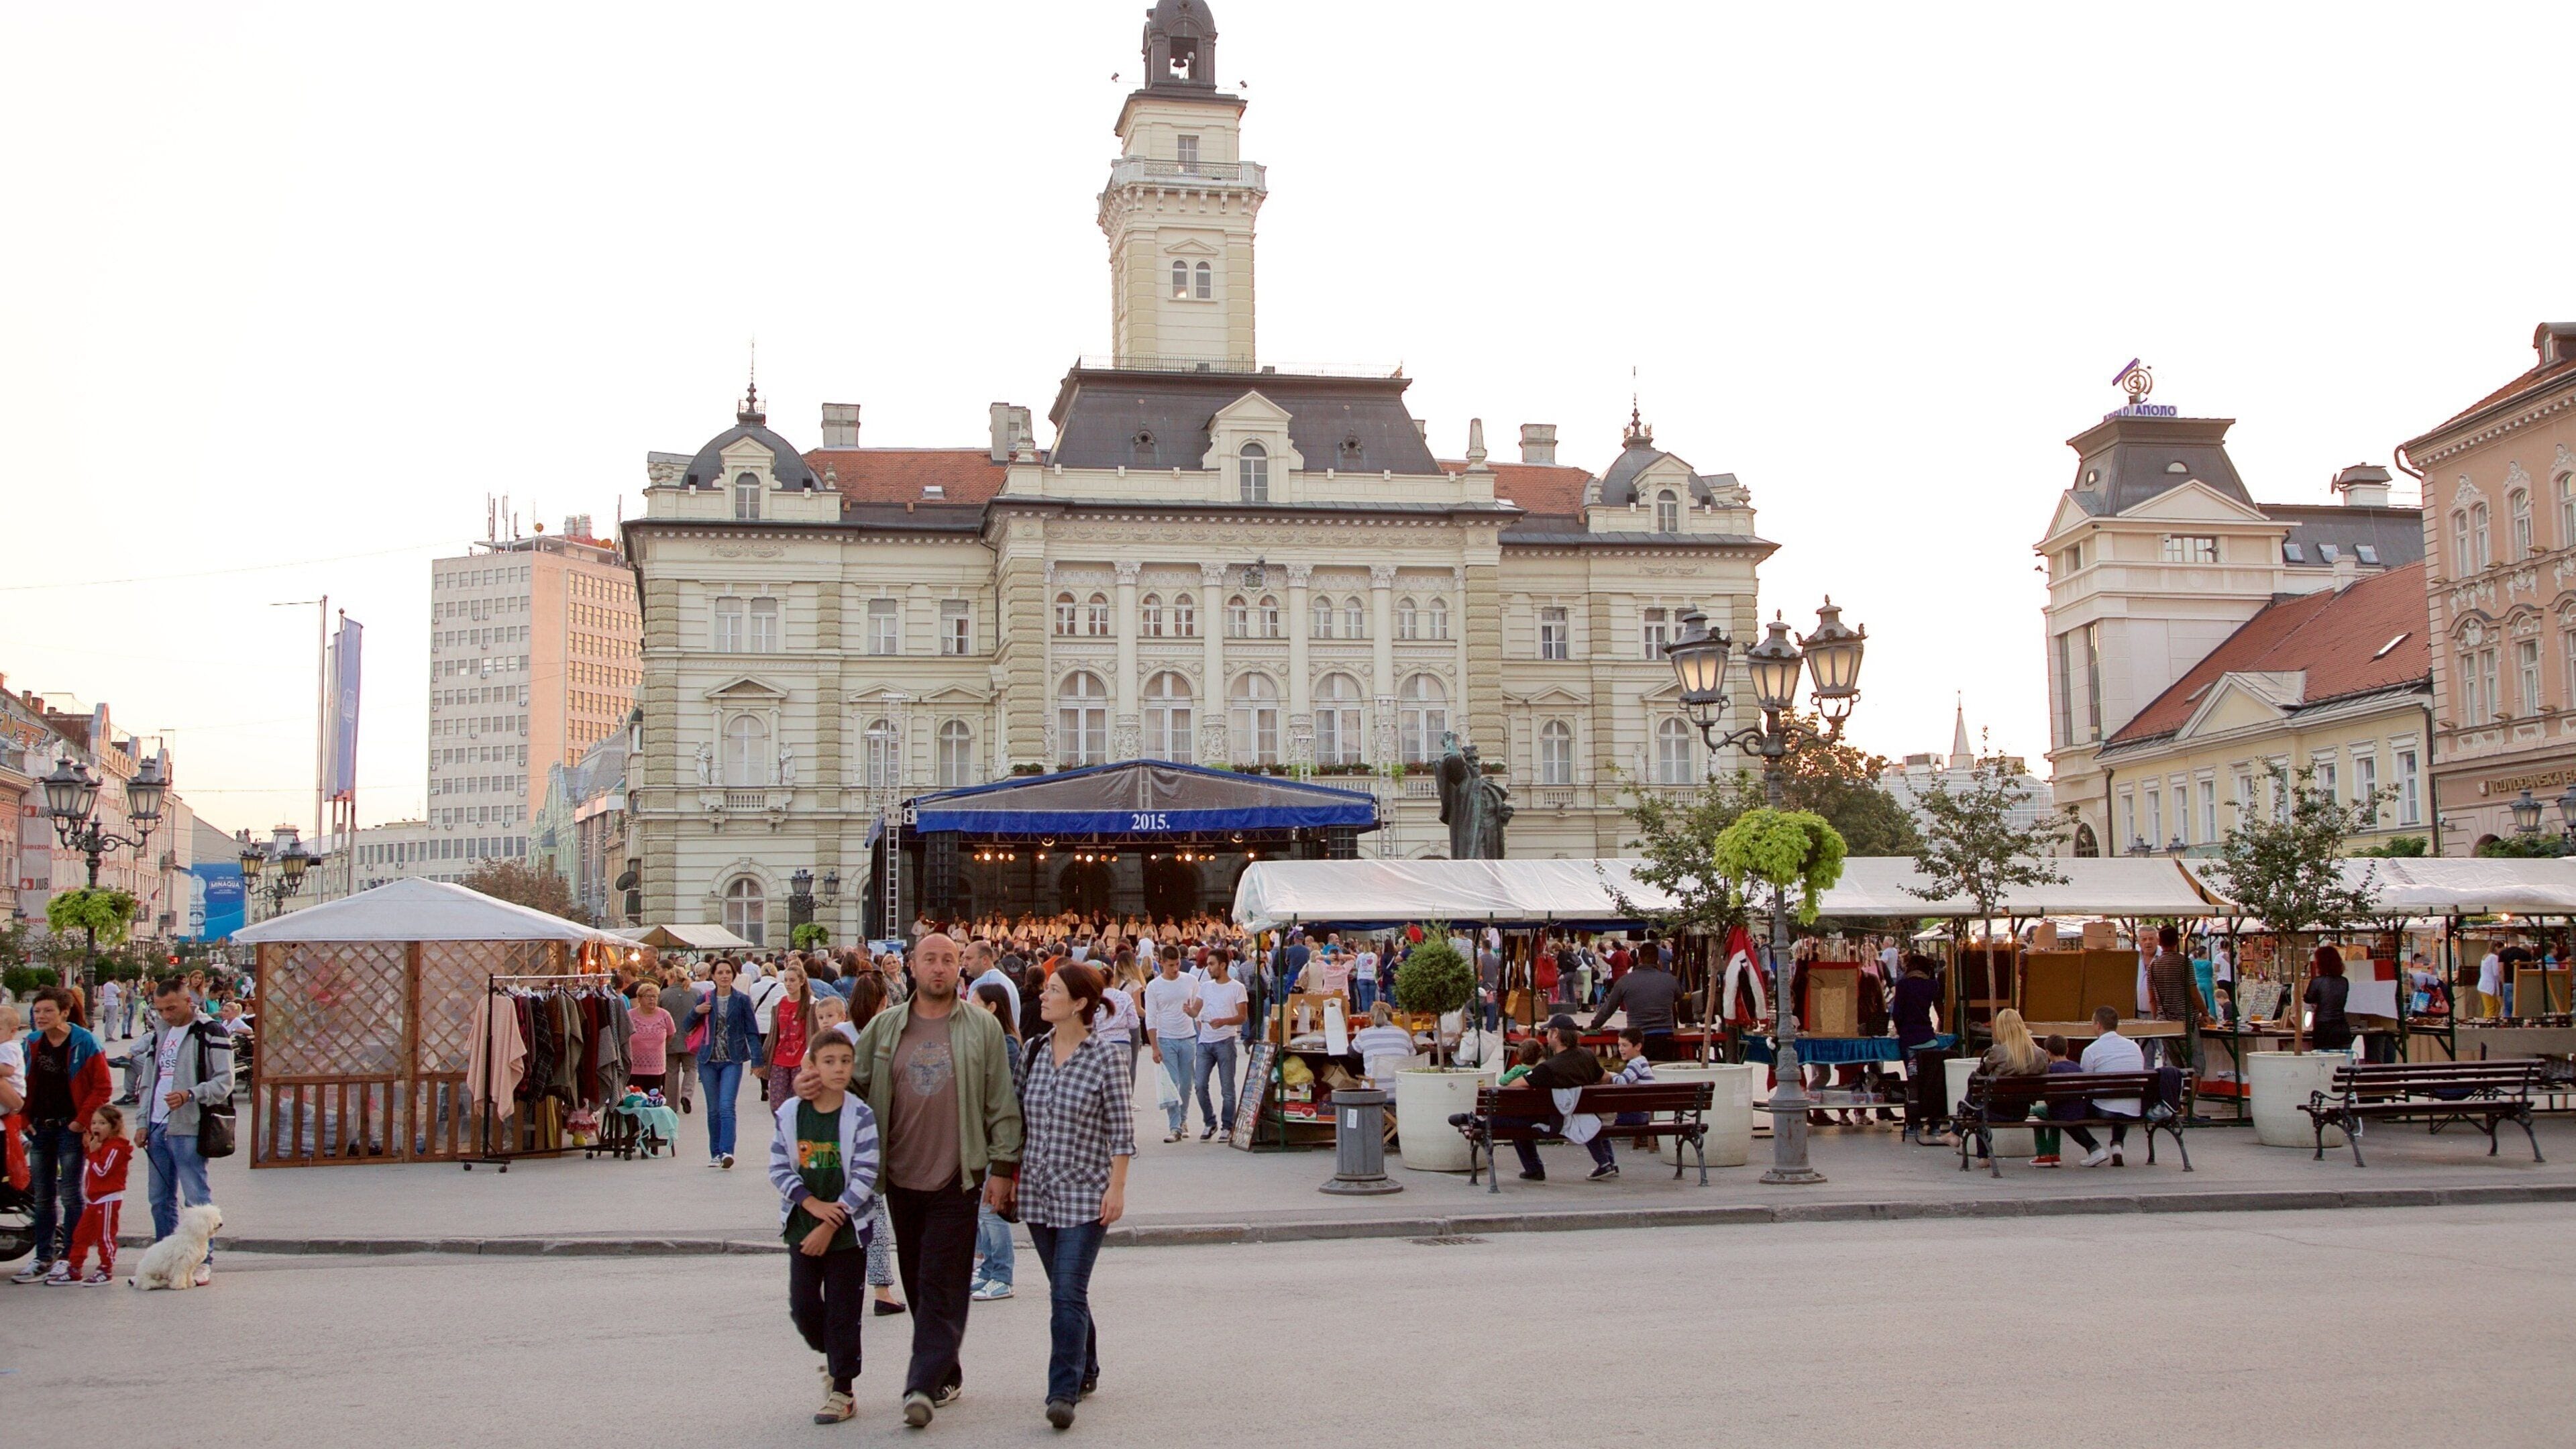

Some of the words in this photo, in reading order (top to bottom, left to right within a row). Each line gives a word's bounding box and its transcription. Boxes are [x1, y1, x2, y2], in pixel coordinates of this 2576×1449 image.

[2135, 405, 2177, 416] АПОЛО
[1131, 813, 1171, 830] 2015.
[34, 877, 49, 890] JUB
